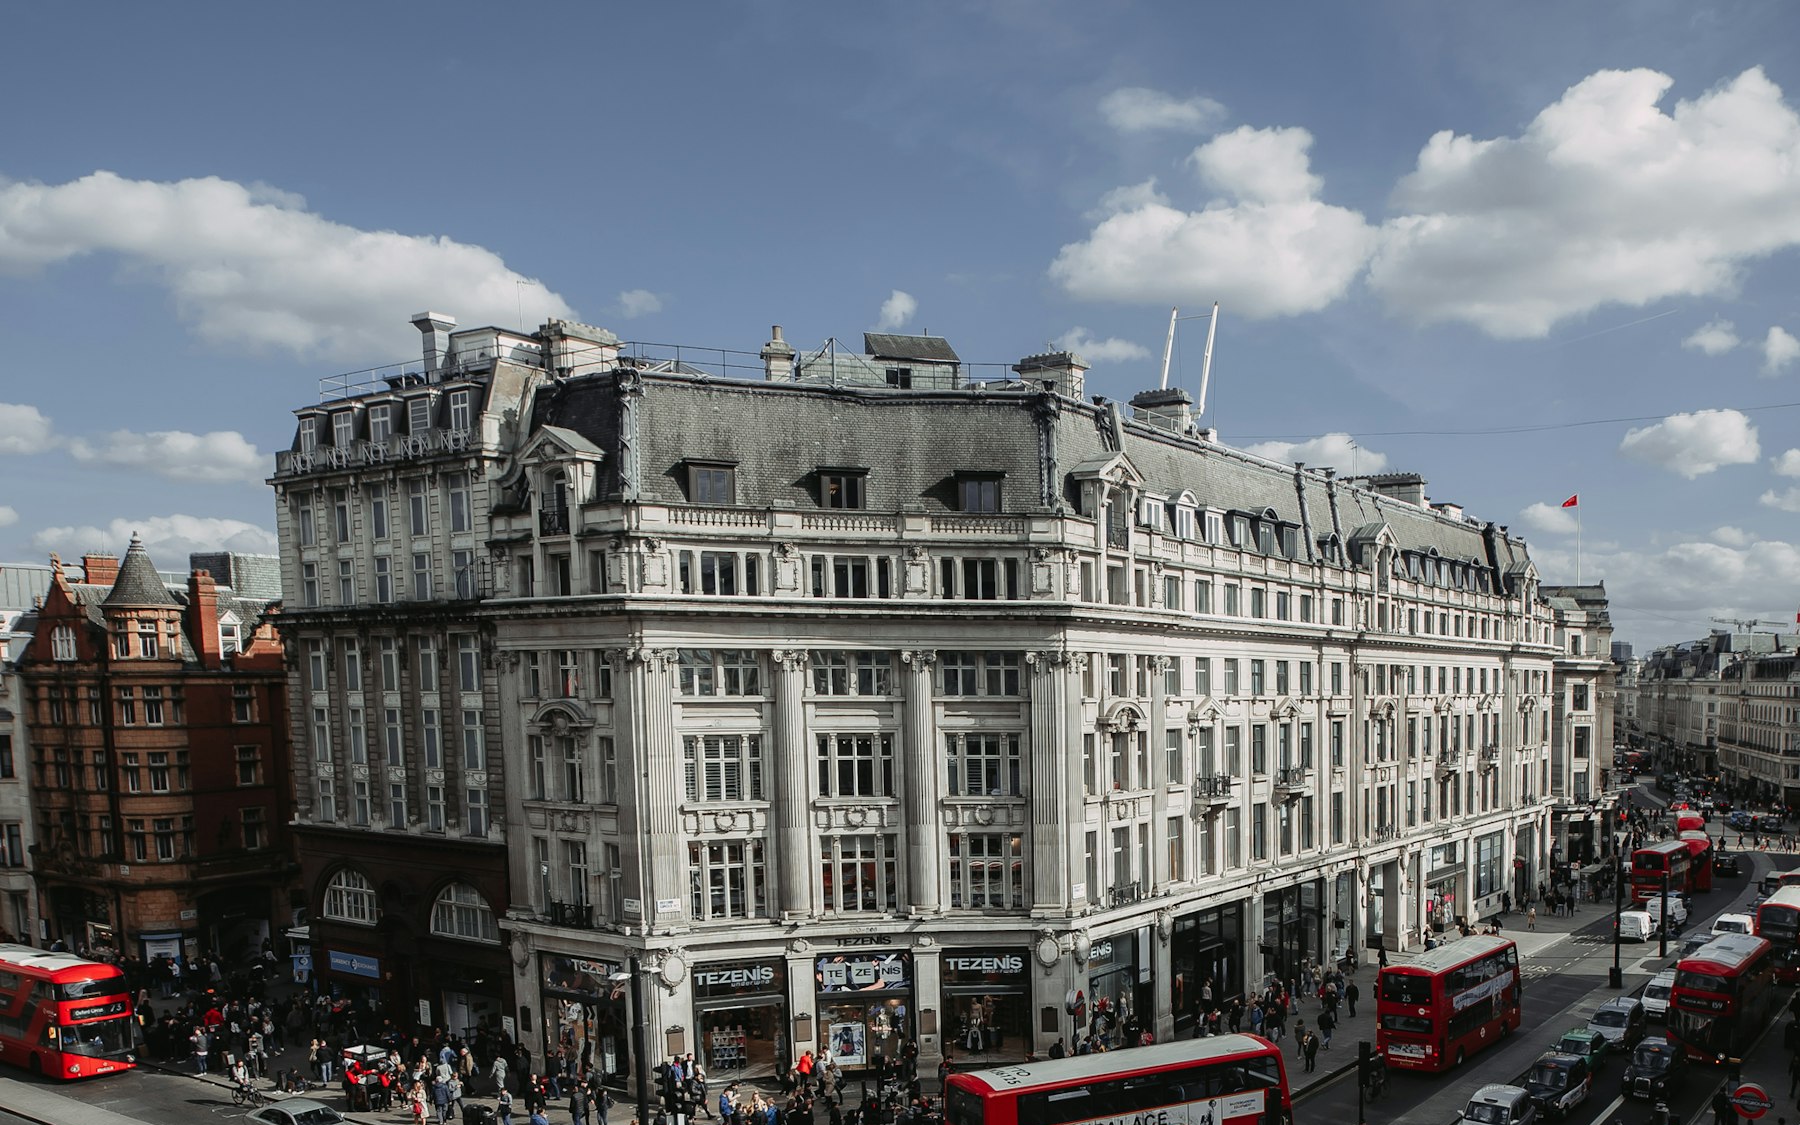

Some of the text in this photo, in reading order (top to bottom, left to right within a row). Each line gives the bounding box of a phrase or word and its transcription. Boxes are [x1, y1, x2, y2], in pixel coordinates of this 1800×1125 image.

[835, 934, 892, 947] TEZENIS
[1088, 941, 1113, 960] ENIS
[945, 954, 1024, 971] TEZENIS
[694, 965, 774, 986] TEZENIS
[827, 969, 843, 978] TE
[855, 967, 872, 977] ZE
[1401, 993, 1412, 1003] 25
[1729, 1097, 1771, 1108] UNDERGROUND
